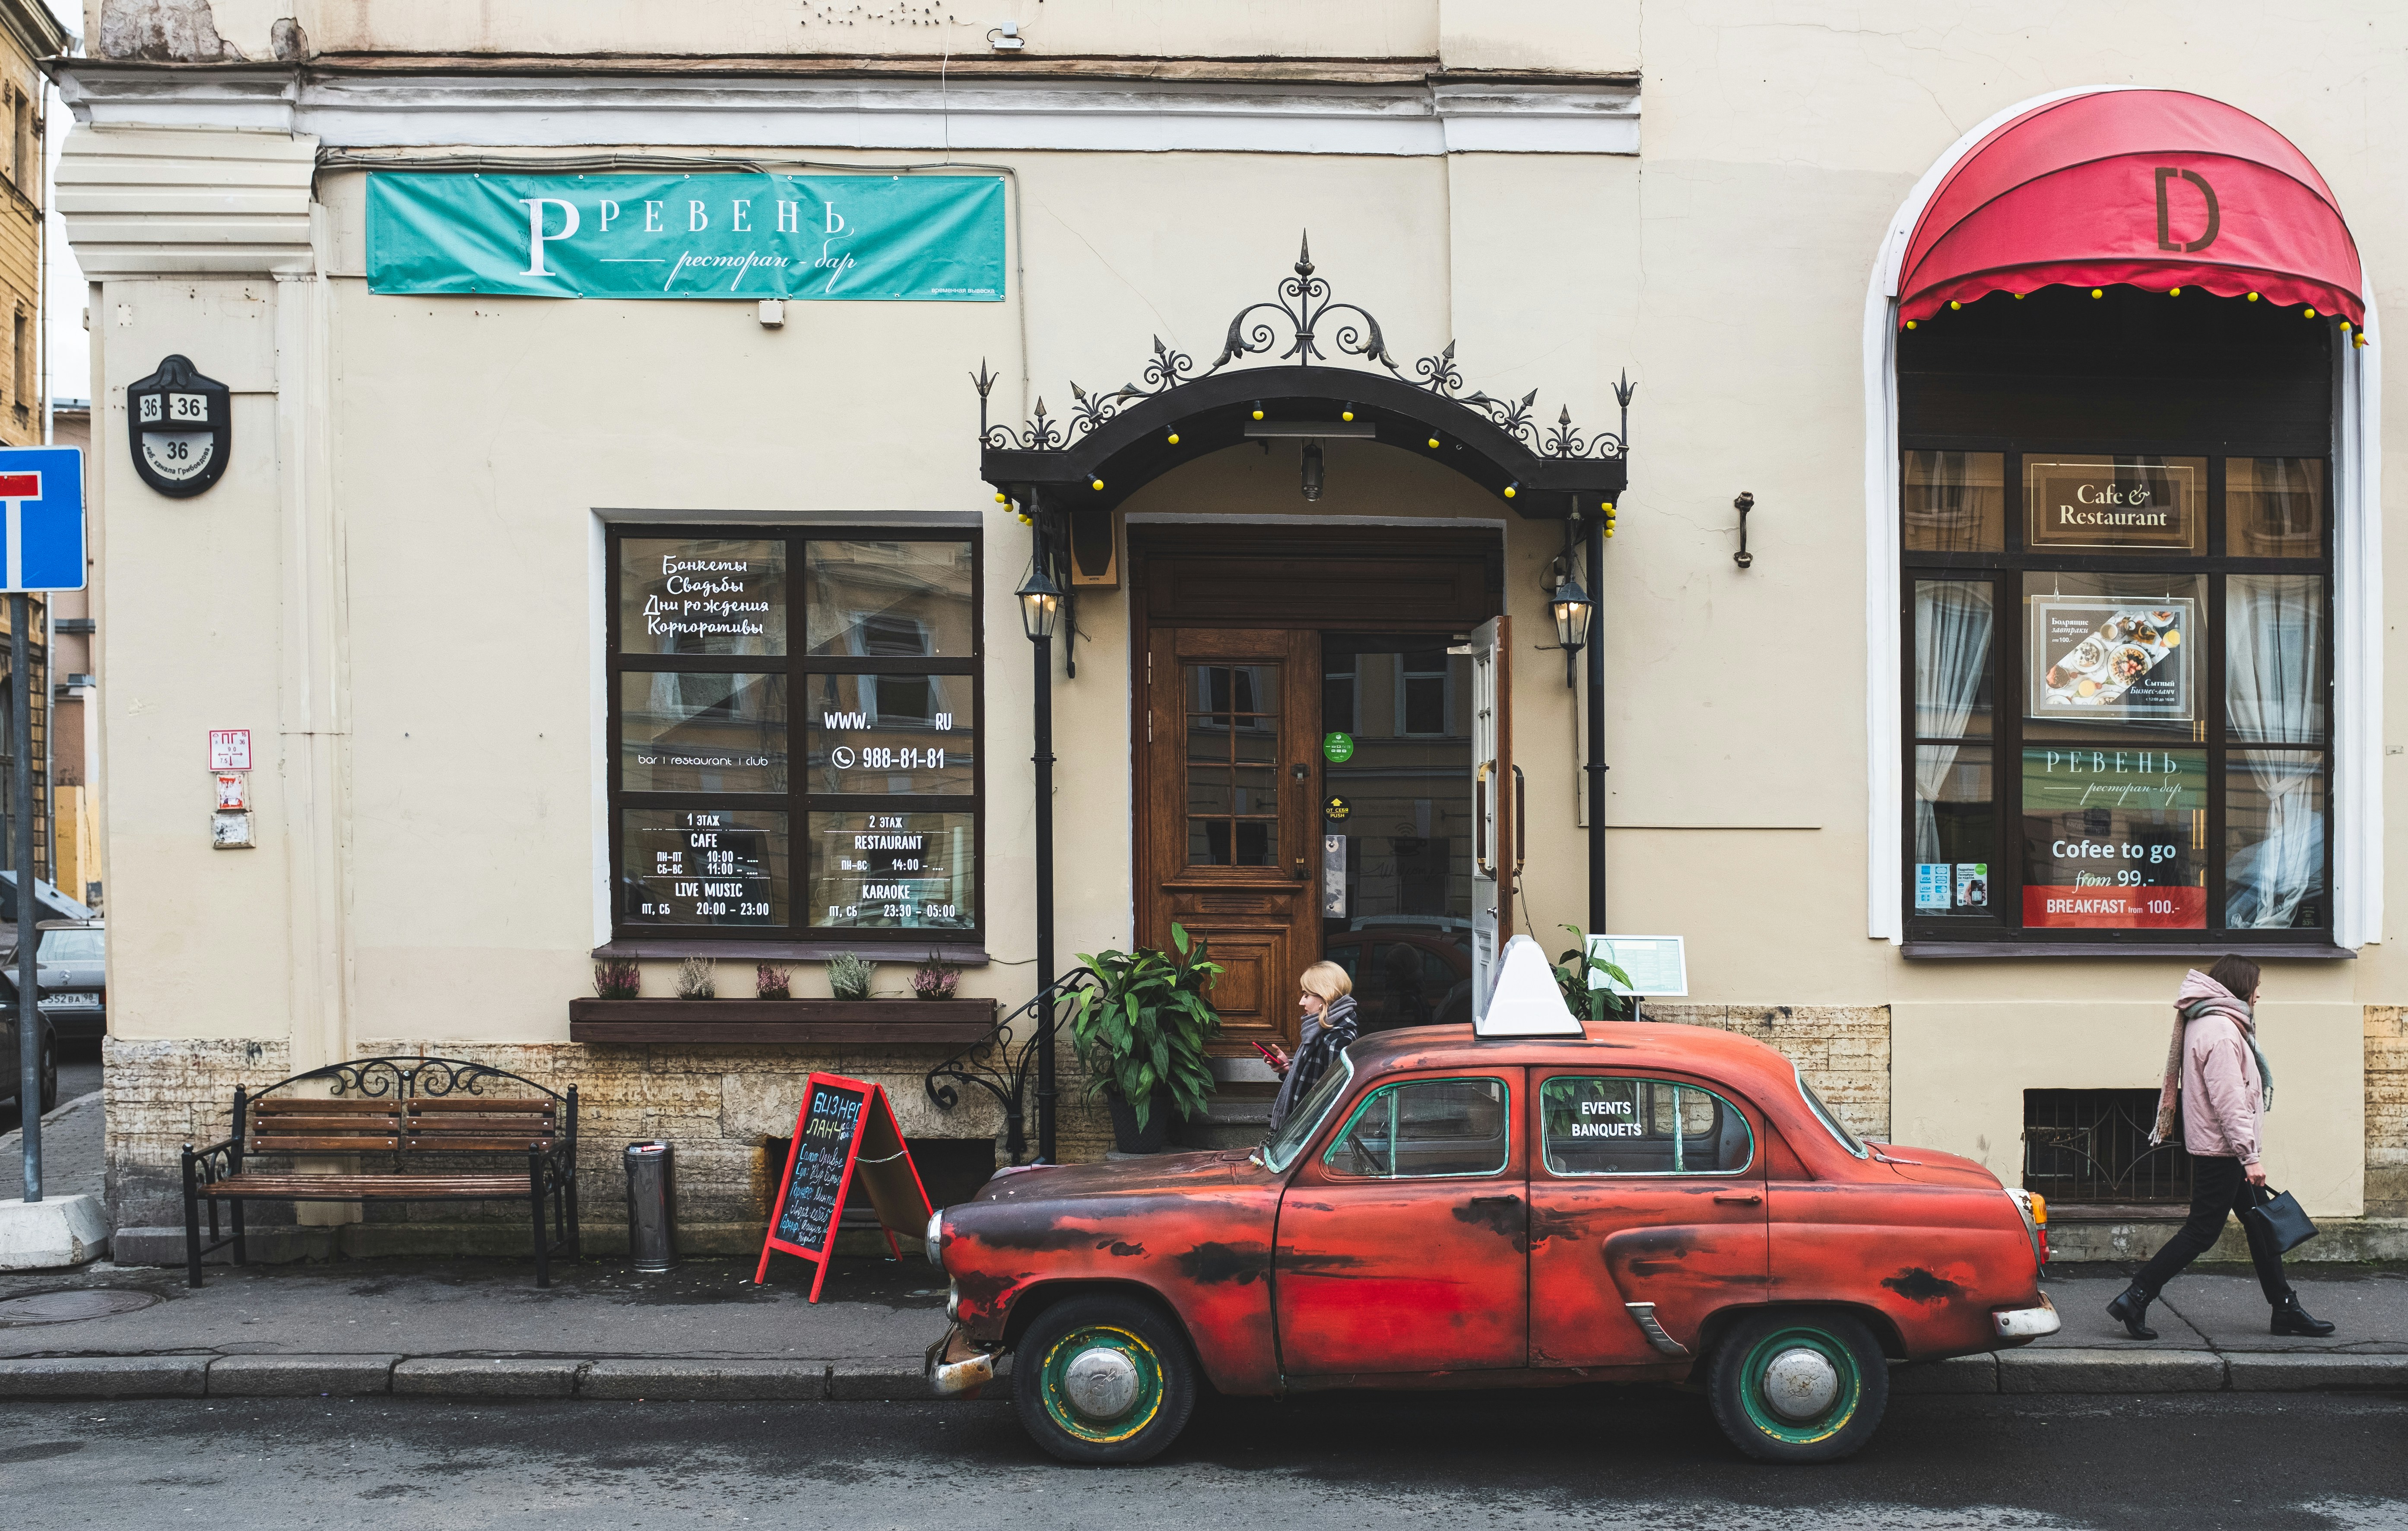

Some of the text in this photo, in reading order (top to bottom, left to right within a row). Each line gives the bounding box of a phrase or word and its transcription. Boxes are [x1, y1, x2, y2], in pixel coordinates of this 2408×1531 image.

[600, 200, 855, 235] РЕВЕНЬ
[2154, 167, 2220, 253] D
[662, 250, 790, 292] ресторан
[815, 240, 854, 293] бар
[145, 398, 157, 417] 36
[178, 397, 200, 416] 36
[167, 441, 188, 460] 36
[153, 460, 176, 474] канала
[2077, 483, 2151, 505] Cafe &
[2059, 503, 2167, 526] Restaurant
[662, 554, 748, 575] Банкеты
[666, 575, 744, 598] Свадьбы
[642, 593, 769, 617] Дни рождения
[647, 614, 764, 638] Корпоративы
[2051, 627, 2088, 635] завтраки
[2130, 686, 2175, 695] Бизнес-ланч
[2145, 678, 2175, 687] Сытный
[824, 711, 952, 731] WWW. RU
[638, 754, 658, 765] bar
[670, 757, 733, 766] restaurant
[746, 756, 768, 767] club
[862, 747, 944, 769] 988-81-81
[2046, 751, 2182, 774] РЕВЕНЬ
[2078, 782, 2150, 806] ресторан
[2159, 776, 2182, 807] бар
[686, 812, 720, 827] 1 ЭТАЖ
[869, 815, 903, 828] 2 ЭТАЖ
[690, 833, 718, 848] CAFE
[854, 834, 923, 850] RESTAURANT
[657, 851, 683, 862] ПН-ПТ
[707, 850, 734, 863] 10:00
[2052, 839, 2176, 864] Cofee to go
[657, 863, 683, 875] СБ-ВС
[707, 862, 733, 875] 11:00
[841, 859, 868, 871] ПН-ВС
[891, 858, 919, 871] 14:00
[675, 882, 743, 897] LIVE MUSIC
[2072, 869, 2112, 894] from
[862, 884, 911, 900] KARAOKE
[659, 903, 671, 915] СБ
[696, 901, 726, 916] 20:00
[740, 902, 769, 916] 23:00
[846, 905, 858, 917] СБ
[883, 903, 912, 917] 23:30
[926, 904, 955, 918] 05:00
[2046, 899, 2126, 914] BREAKFAST
[41, 994, 81, 1003] 552BA
[1581, 1101, 1632, 1115] EVENTS
[1571, 1122, 1642, 1138] BANQUETS
